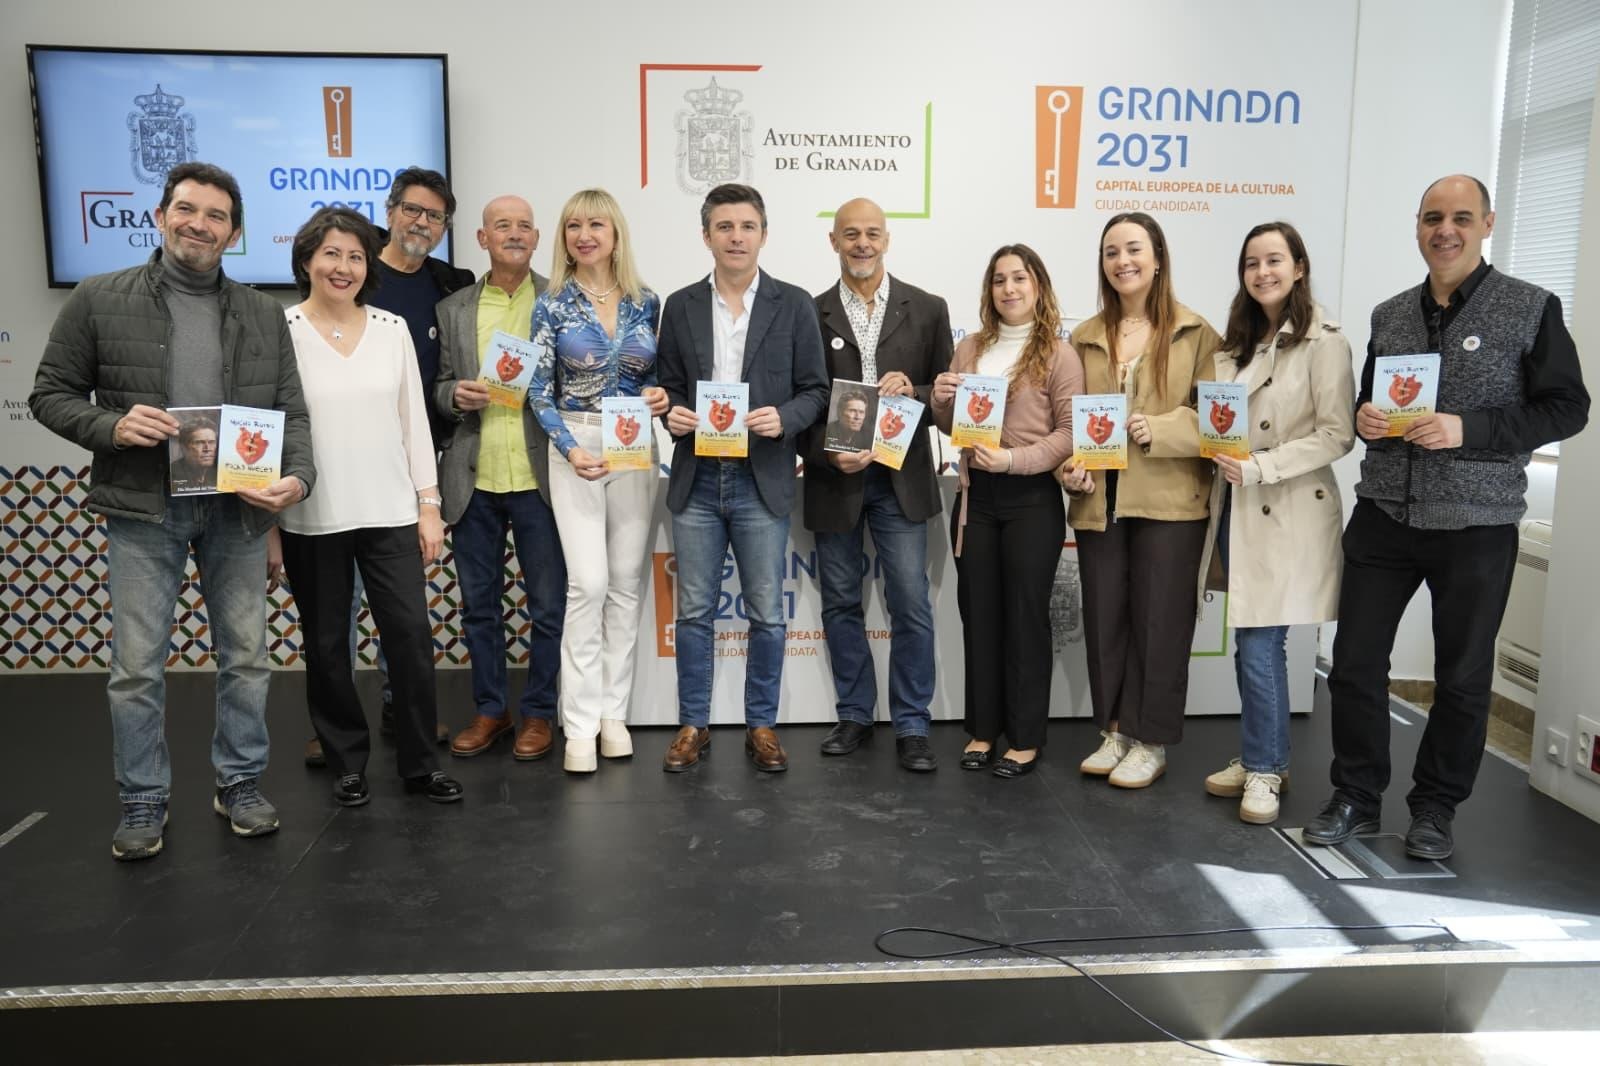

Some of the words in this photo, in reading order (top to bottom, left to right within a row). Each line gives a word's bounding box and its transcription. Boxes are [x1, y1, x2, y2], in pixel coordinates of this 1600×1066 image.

[1098, 86, 1300, 124] GRANADA
[763, 128, 911, 148] AYUNTAMIENTO
[775, 157, 799, 170] DE
[806, 152, 898, 171] GRANADA
[1096, 133, 1188, 172] 2031
[1095, 180, 1144, 192] CAPITAL
[1147, 181, 1204, 193] EUROPEA
[1206, 182, 1222, 193] DE
[1224, 183, 1239, 194] LA
[1241, 183, 1295, 195] CULTURA
[1095, 199, 1140, 211] CIUDAD
[1143, 200, 1211, 213] CANDIDATA
[714, 591, 794, 619] 201
[714, 631, 749, 640] CAPITA
